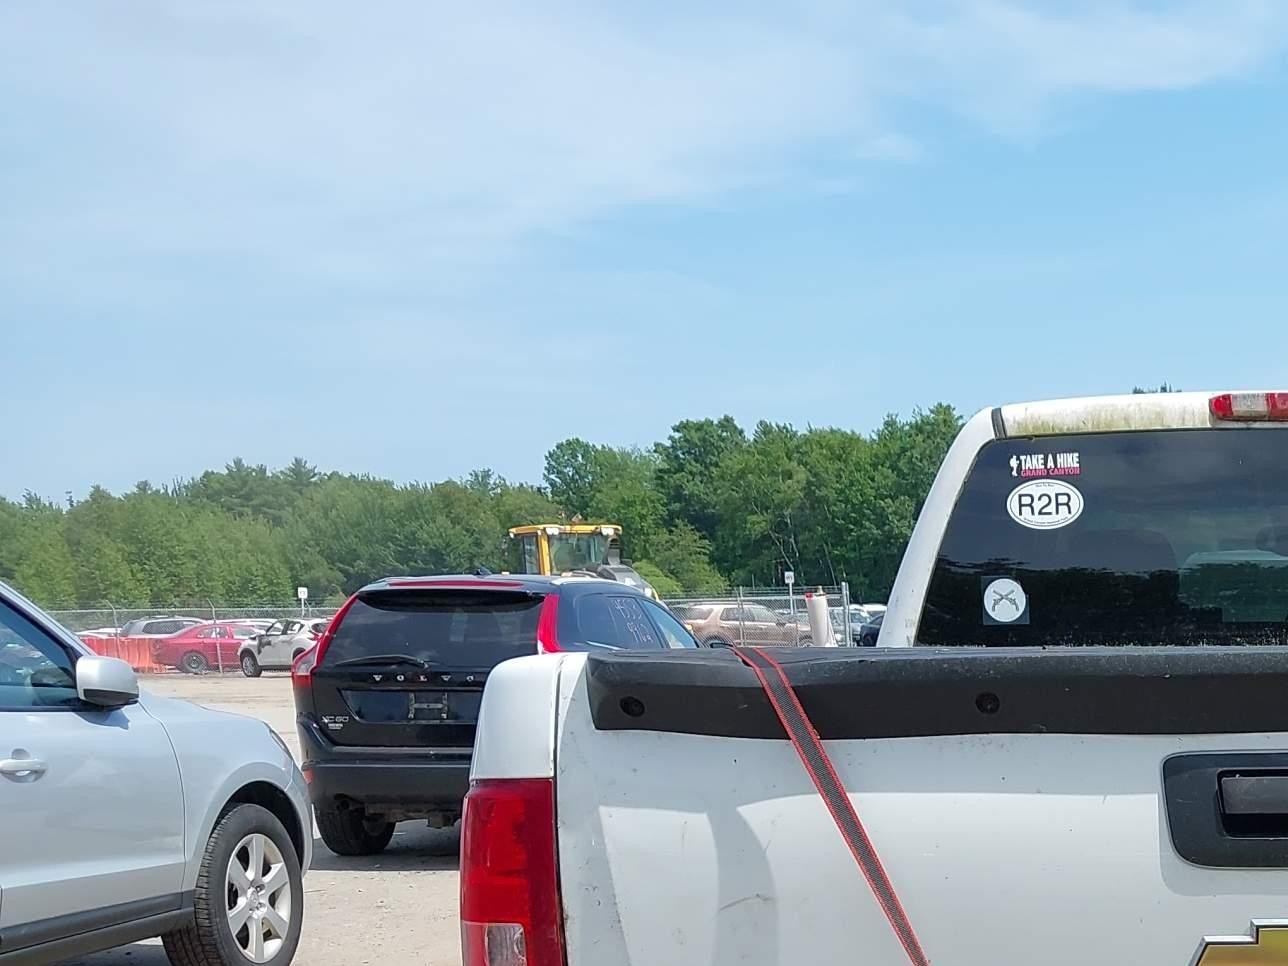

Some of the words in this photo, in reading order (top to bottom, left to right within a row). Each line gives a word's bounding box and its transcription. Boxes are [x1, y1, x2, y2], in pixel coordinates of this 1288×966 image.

[1020, 454, 1045, 469] TAKE
[1047, 453, 1055, 469] A
[1056, 452, 1080, 468] HIKE
[1021, 469, 1047, 477] GRAND
[1049, 467, 1080, 476] CANYON
[1018, 493, 1072, 516] R2R
[372, 674, 474, 682] VOLVO
